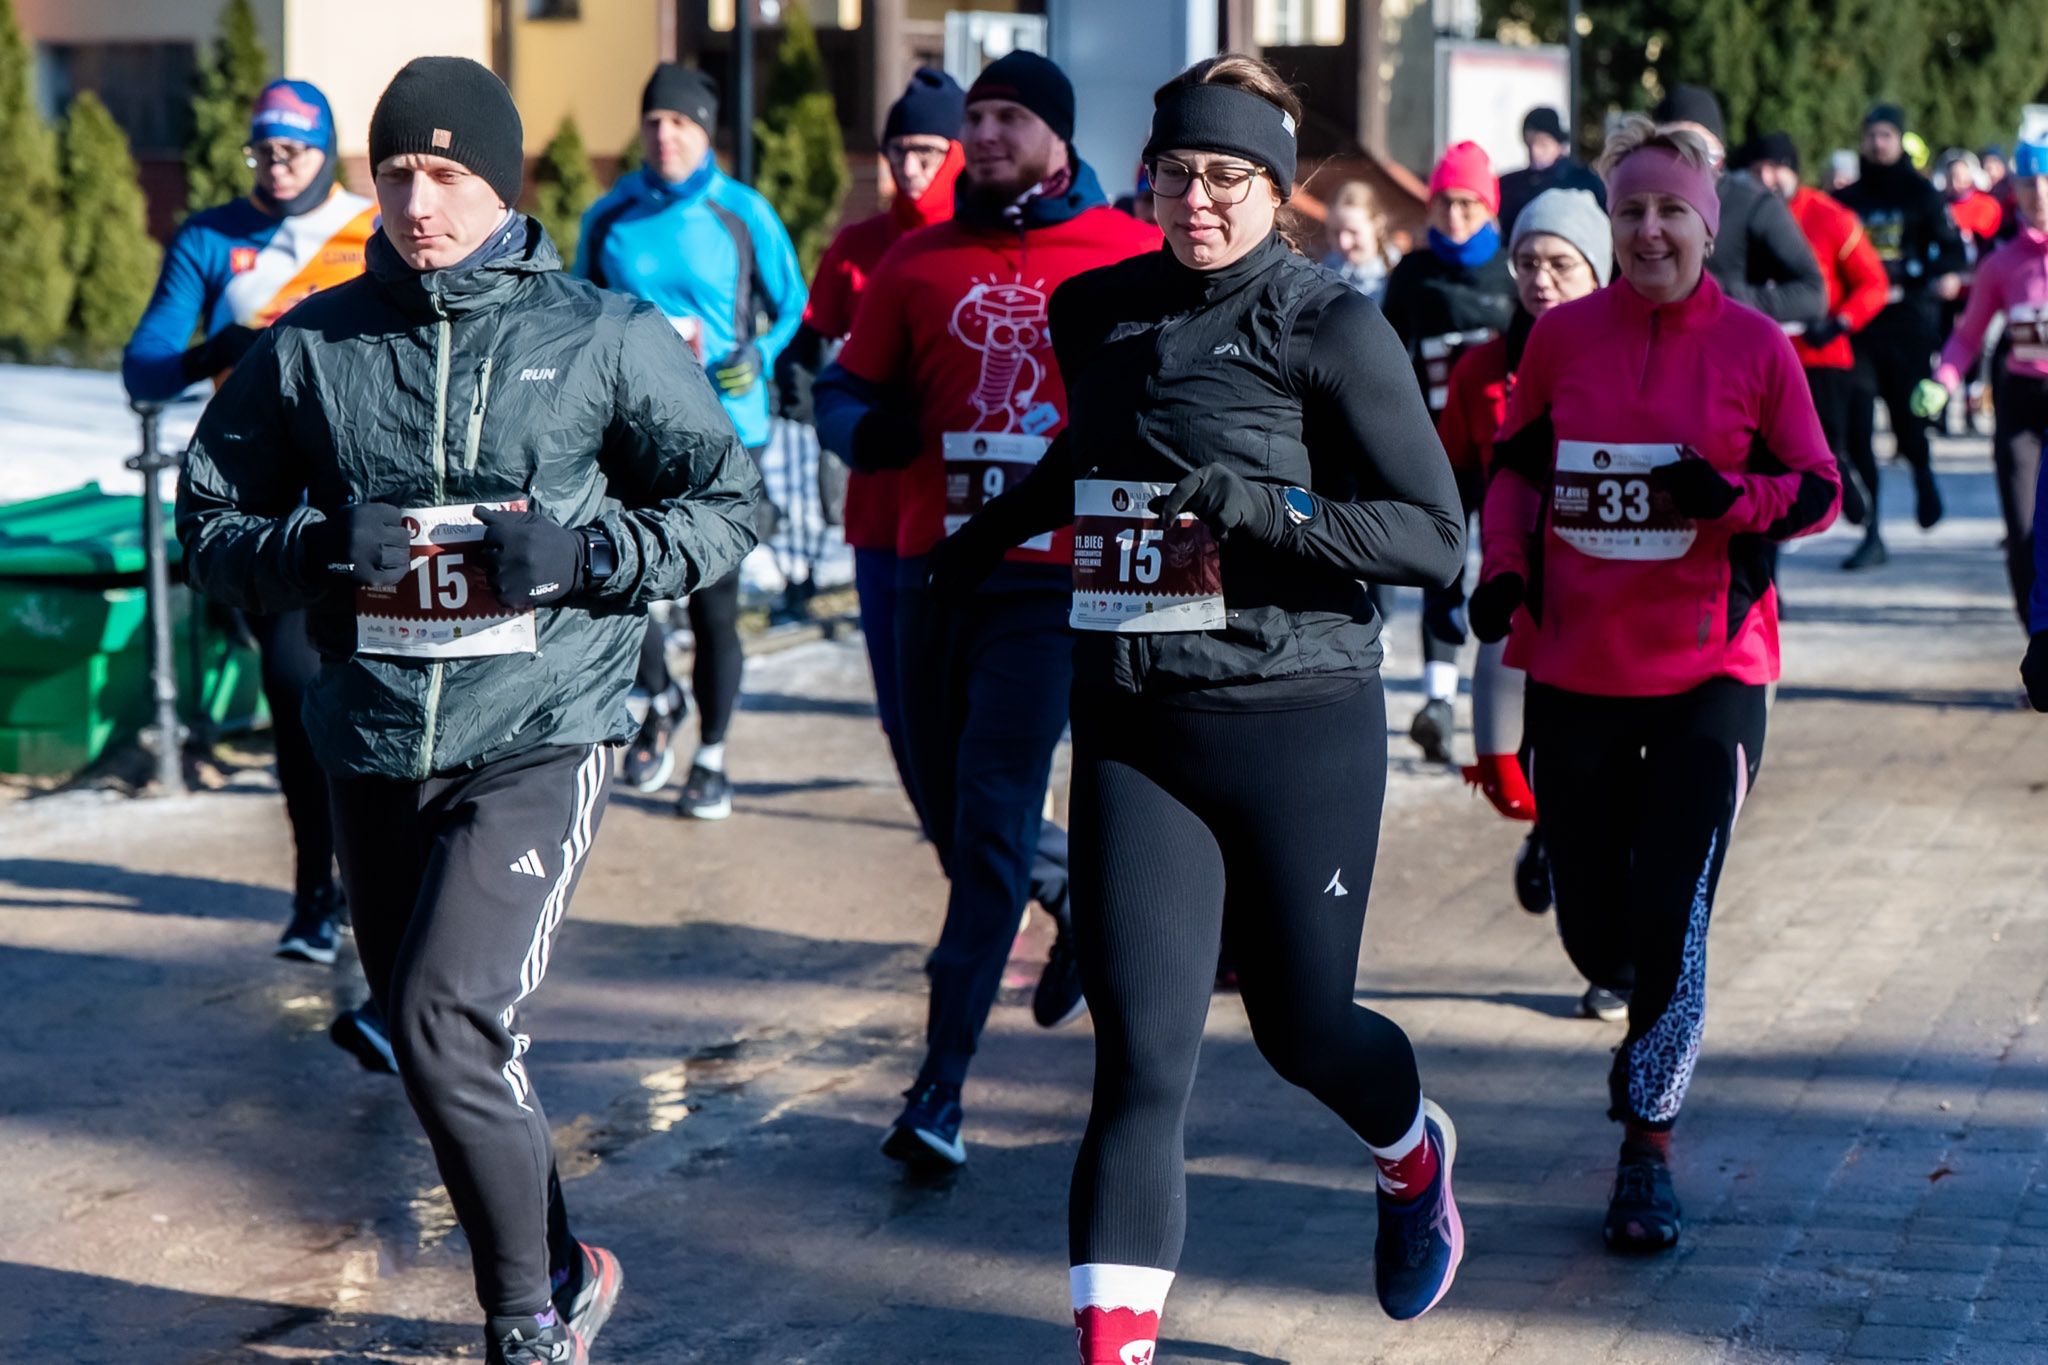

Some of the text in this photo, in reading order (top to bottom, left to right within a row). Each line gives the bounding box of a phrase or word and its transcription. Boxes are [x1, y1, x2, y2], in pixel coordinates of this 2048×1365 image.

[520, 368, 557, 381] RUN
[982, 466, 1005, 505] 9
[1598, 480, 1649, 522] 33
[1075, 535, 1104, 549] 11.BIEG
[1116, 529, 1164, 583] 15
[410, 553, 469, 609] 15
